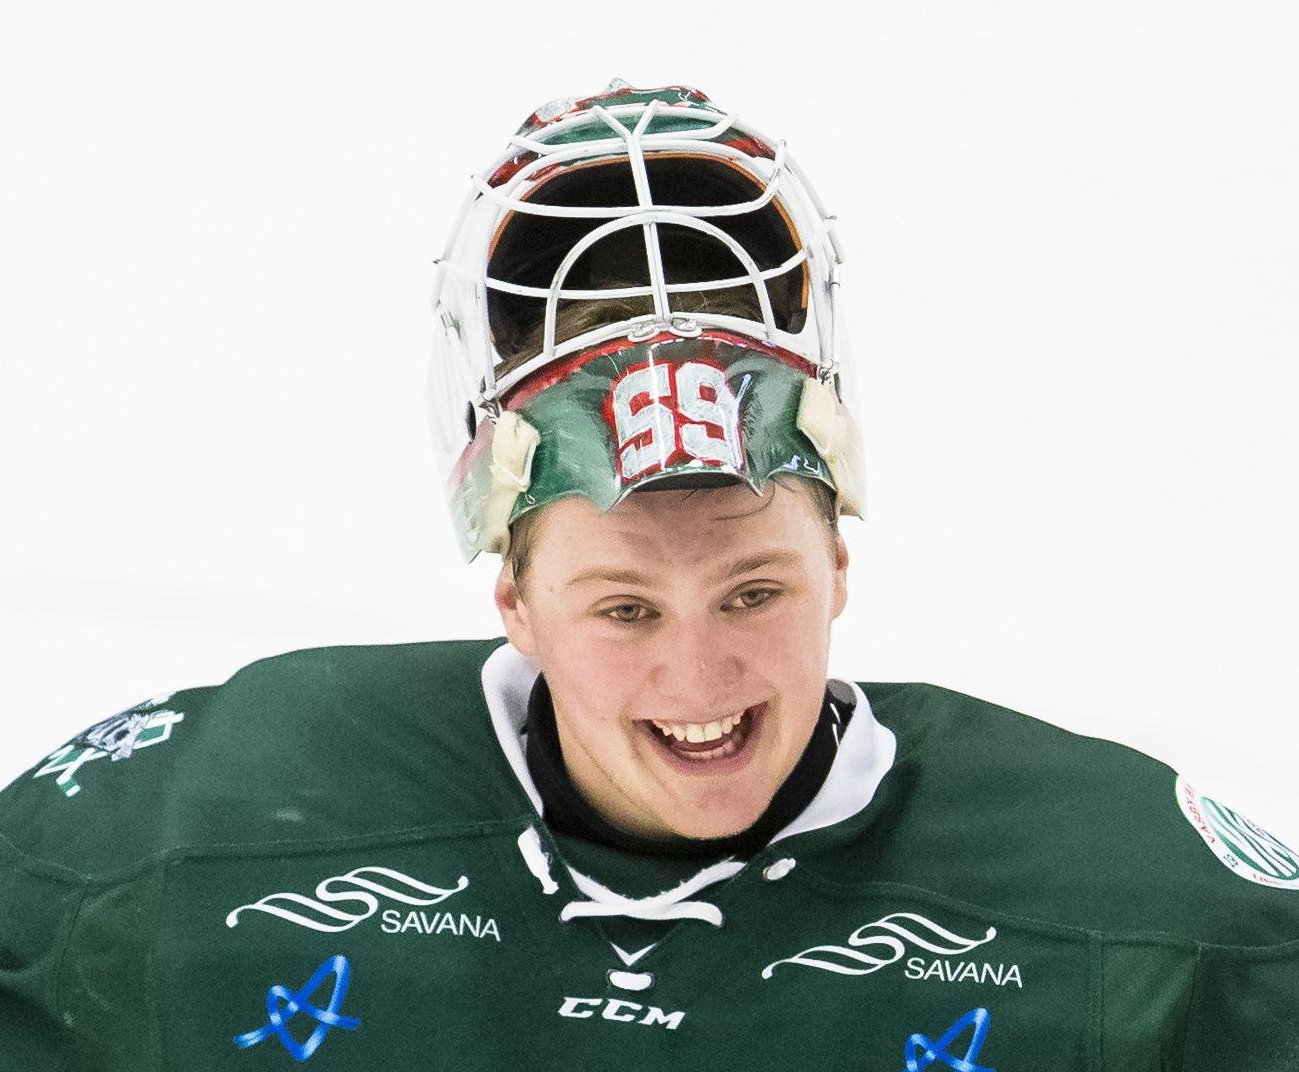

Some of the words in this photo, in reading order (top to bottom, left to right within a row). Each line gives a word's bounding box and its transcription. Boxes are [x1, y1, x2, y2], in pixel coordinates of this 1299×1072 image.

[613, 361, 745, 479] 59
[380, 908, 501, 942] SAVANA
[904, 956, 1023, 989] SAVANA
[557, 996, 686, 1030] CCM
